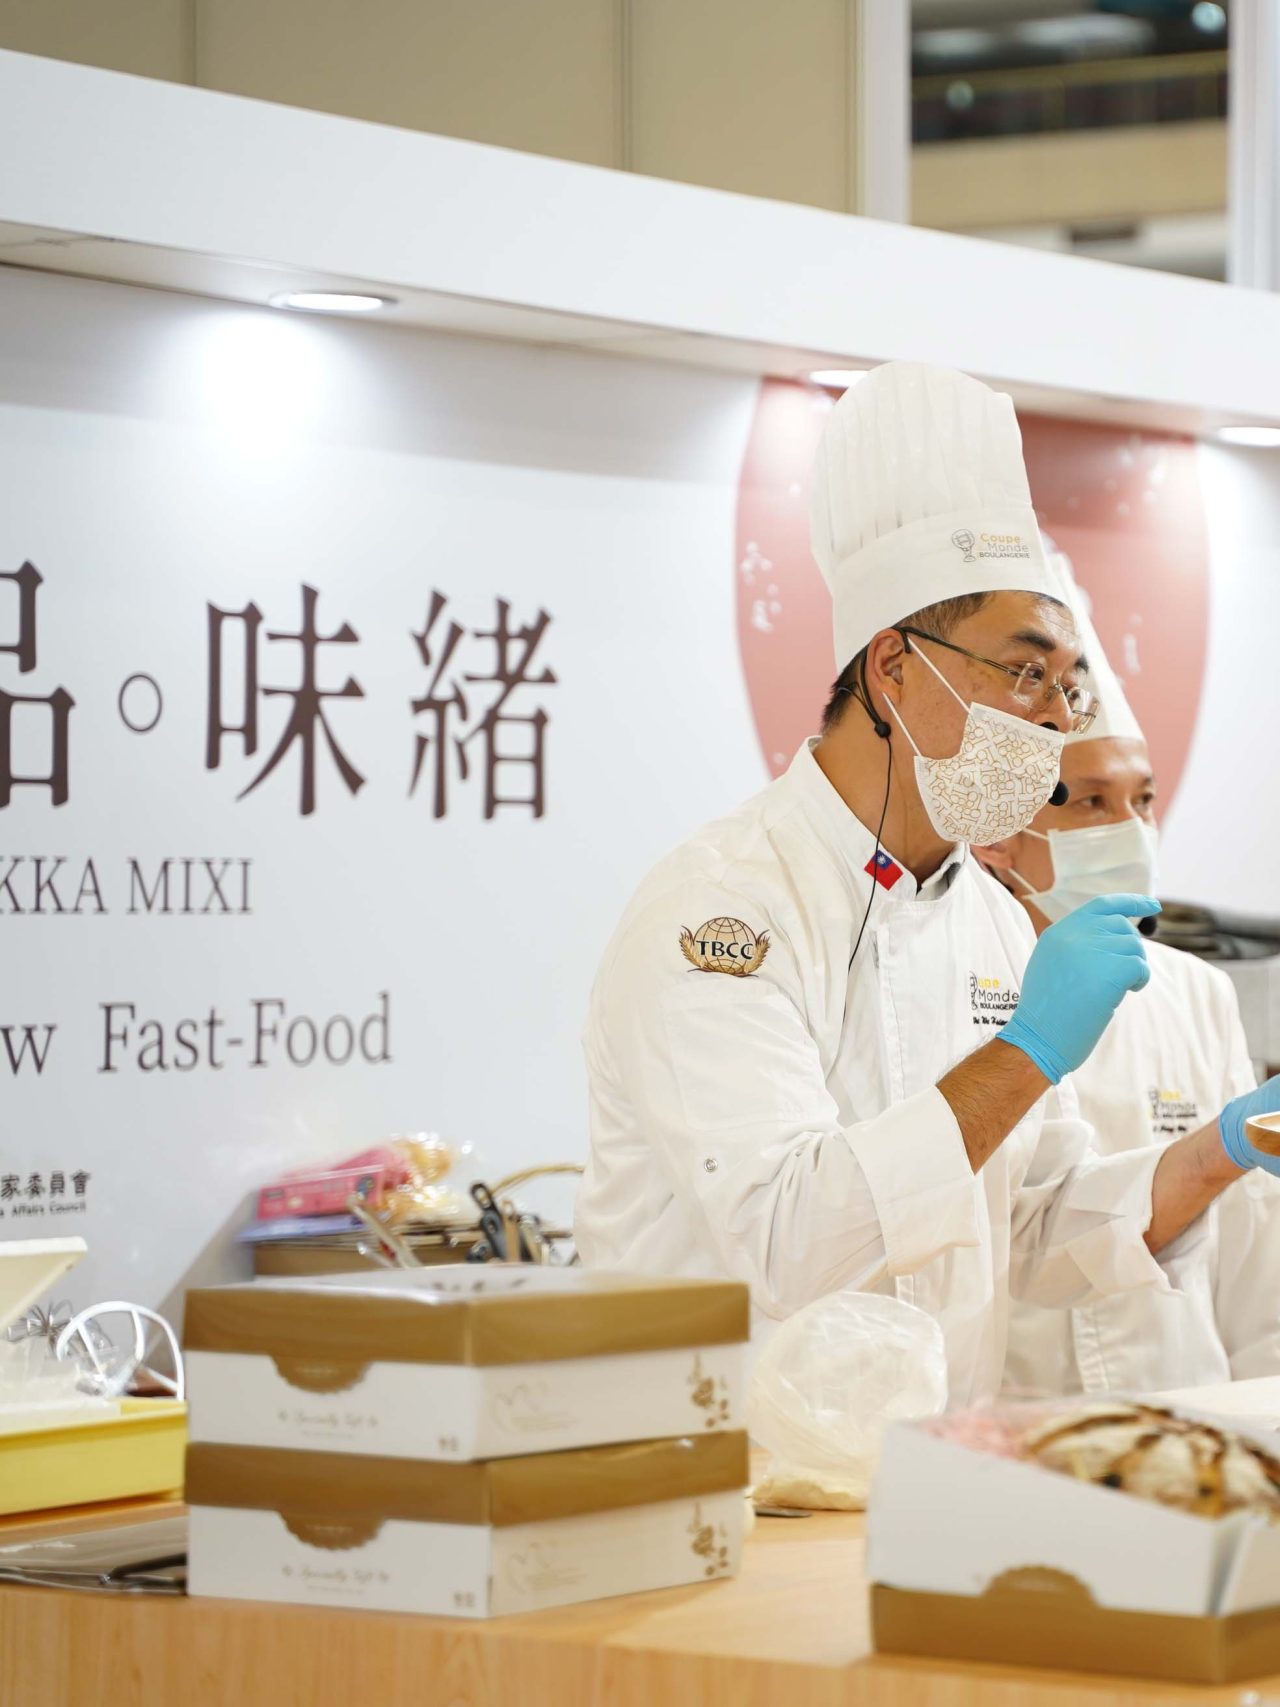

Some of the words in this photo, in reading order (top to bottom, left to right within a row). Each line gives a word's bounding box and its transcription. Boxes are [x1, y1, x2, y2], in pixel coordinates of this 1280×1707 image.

[980, 533, 1021, 544] Coupe
[987, 543, 1029, 552] Monde
[126, 857, 253, 915] MIXI
[696, 940, 754, 960] TBCC
[978, 989, 1020, 1002] Monde
[0, 1024, 58, 1076] w
[98, 990, 393, 1074] Fast-Food
[1, 1169, 91, 1200] 家委員會
